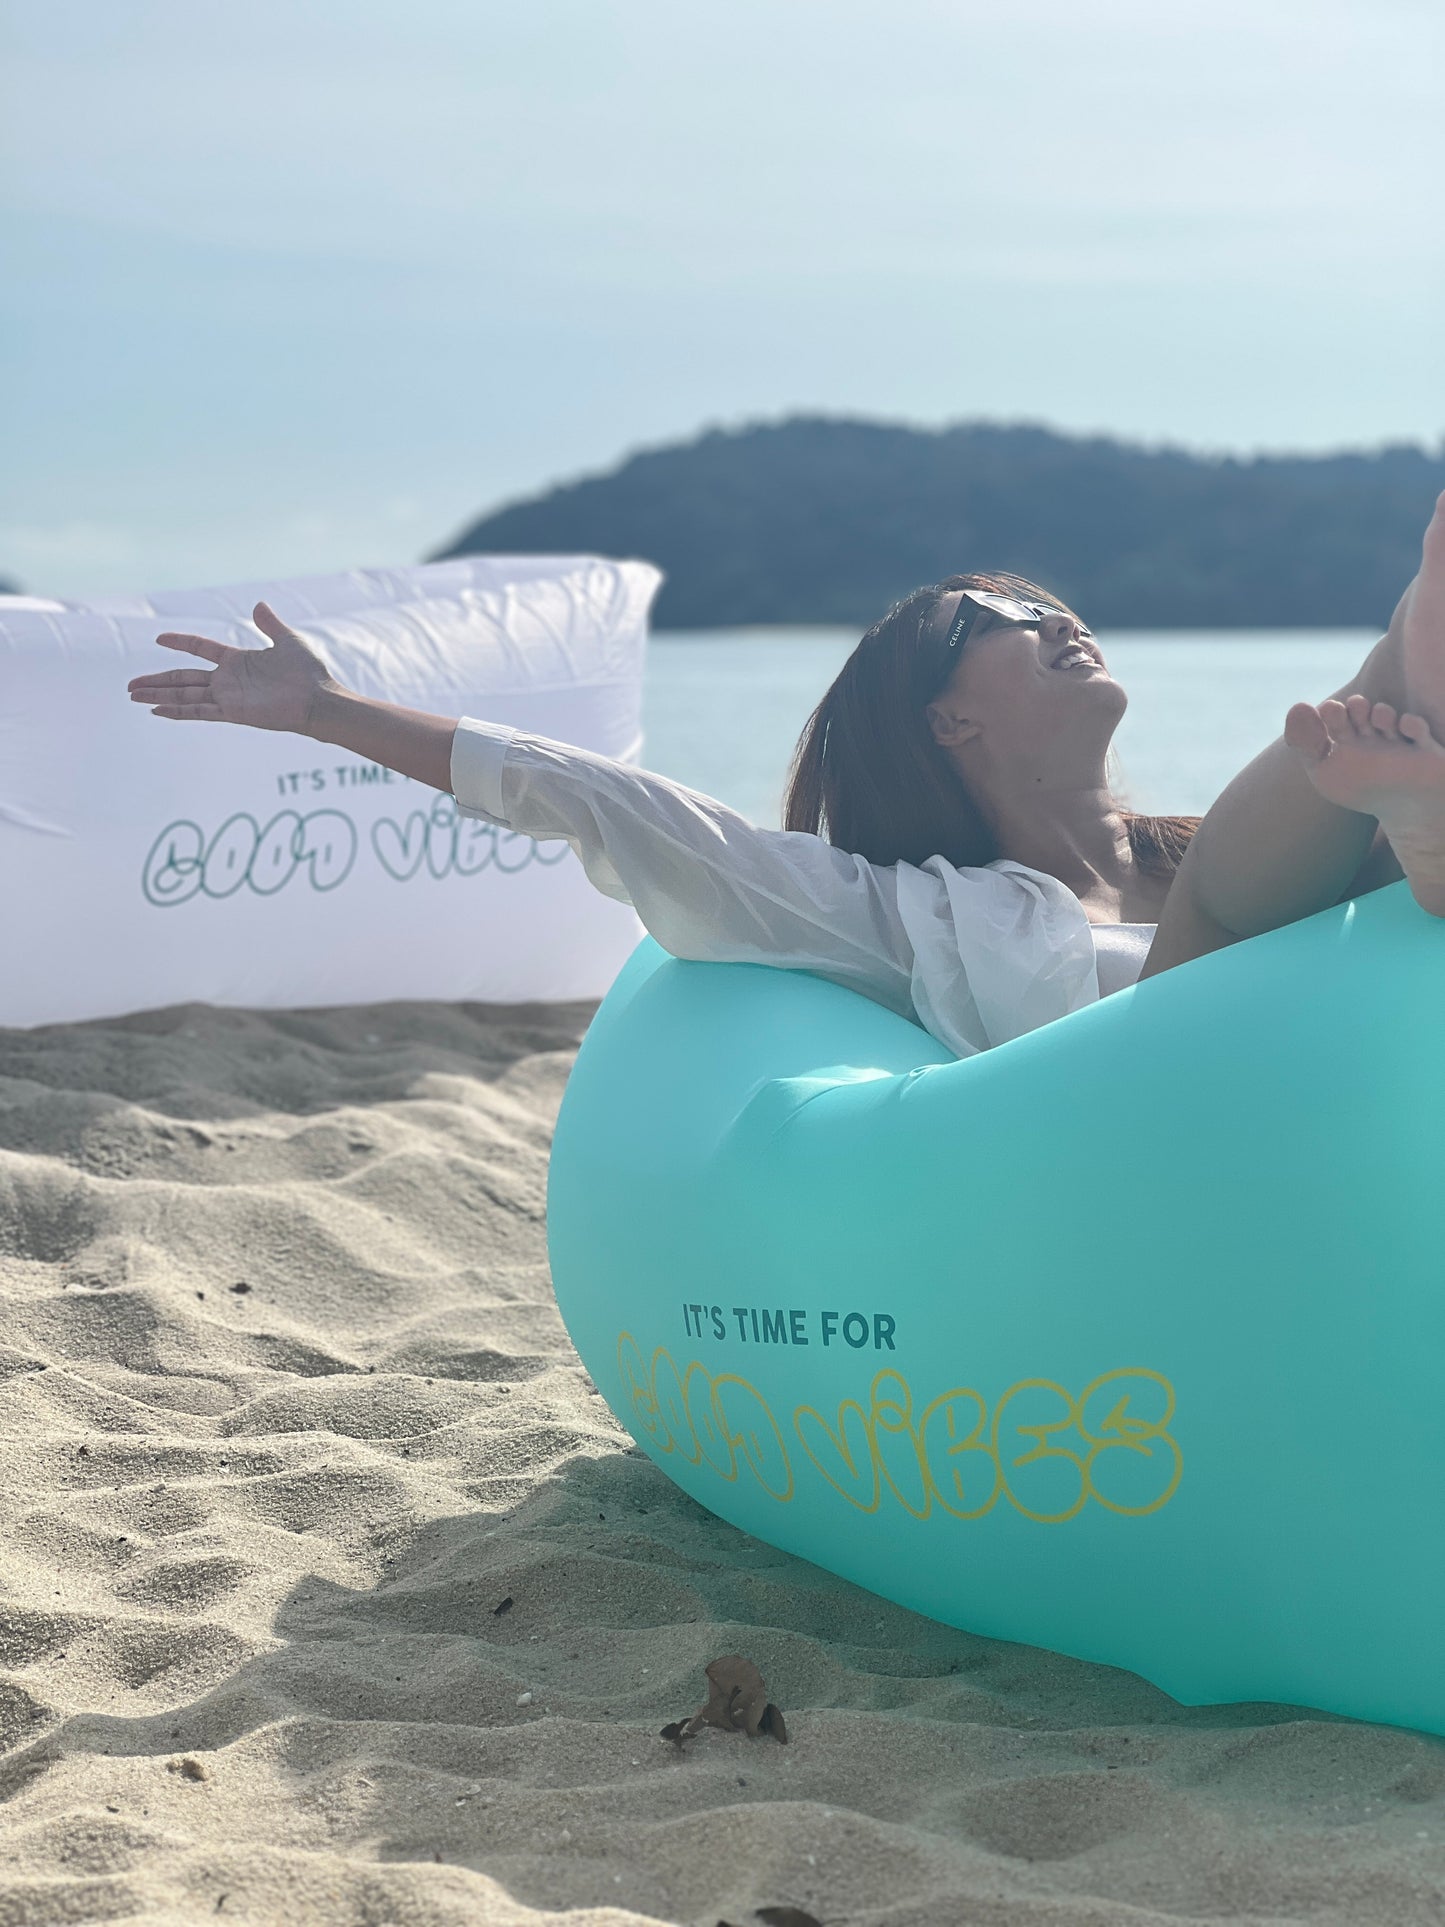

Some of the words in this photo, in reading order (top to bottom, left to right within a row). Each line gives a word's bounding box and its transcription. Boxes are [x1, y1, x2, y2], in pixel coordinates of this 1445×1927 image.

[949, 618, 966, 647] CELINE
[277, 768, 325, 796] IT'S
[334, 764, 394, 786] TIME
[141, 808, 358, 908] GOOD
[682, 1303, 726, 1341] IT'S
[732, 1307, 809, 1345] TIME
[821, 1310, 897, 1351] FOR
[617, 1331, 795, 1502] GOOD
